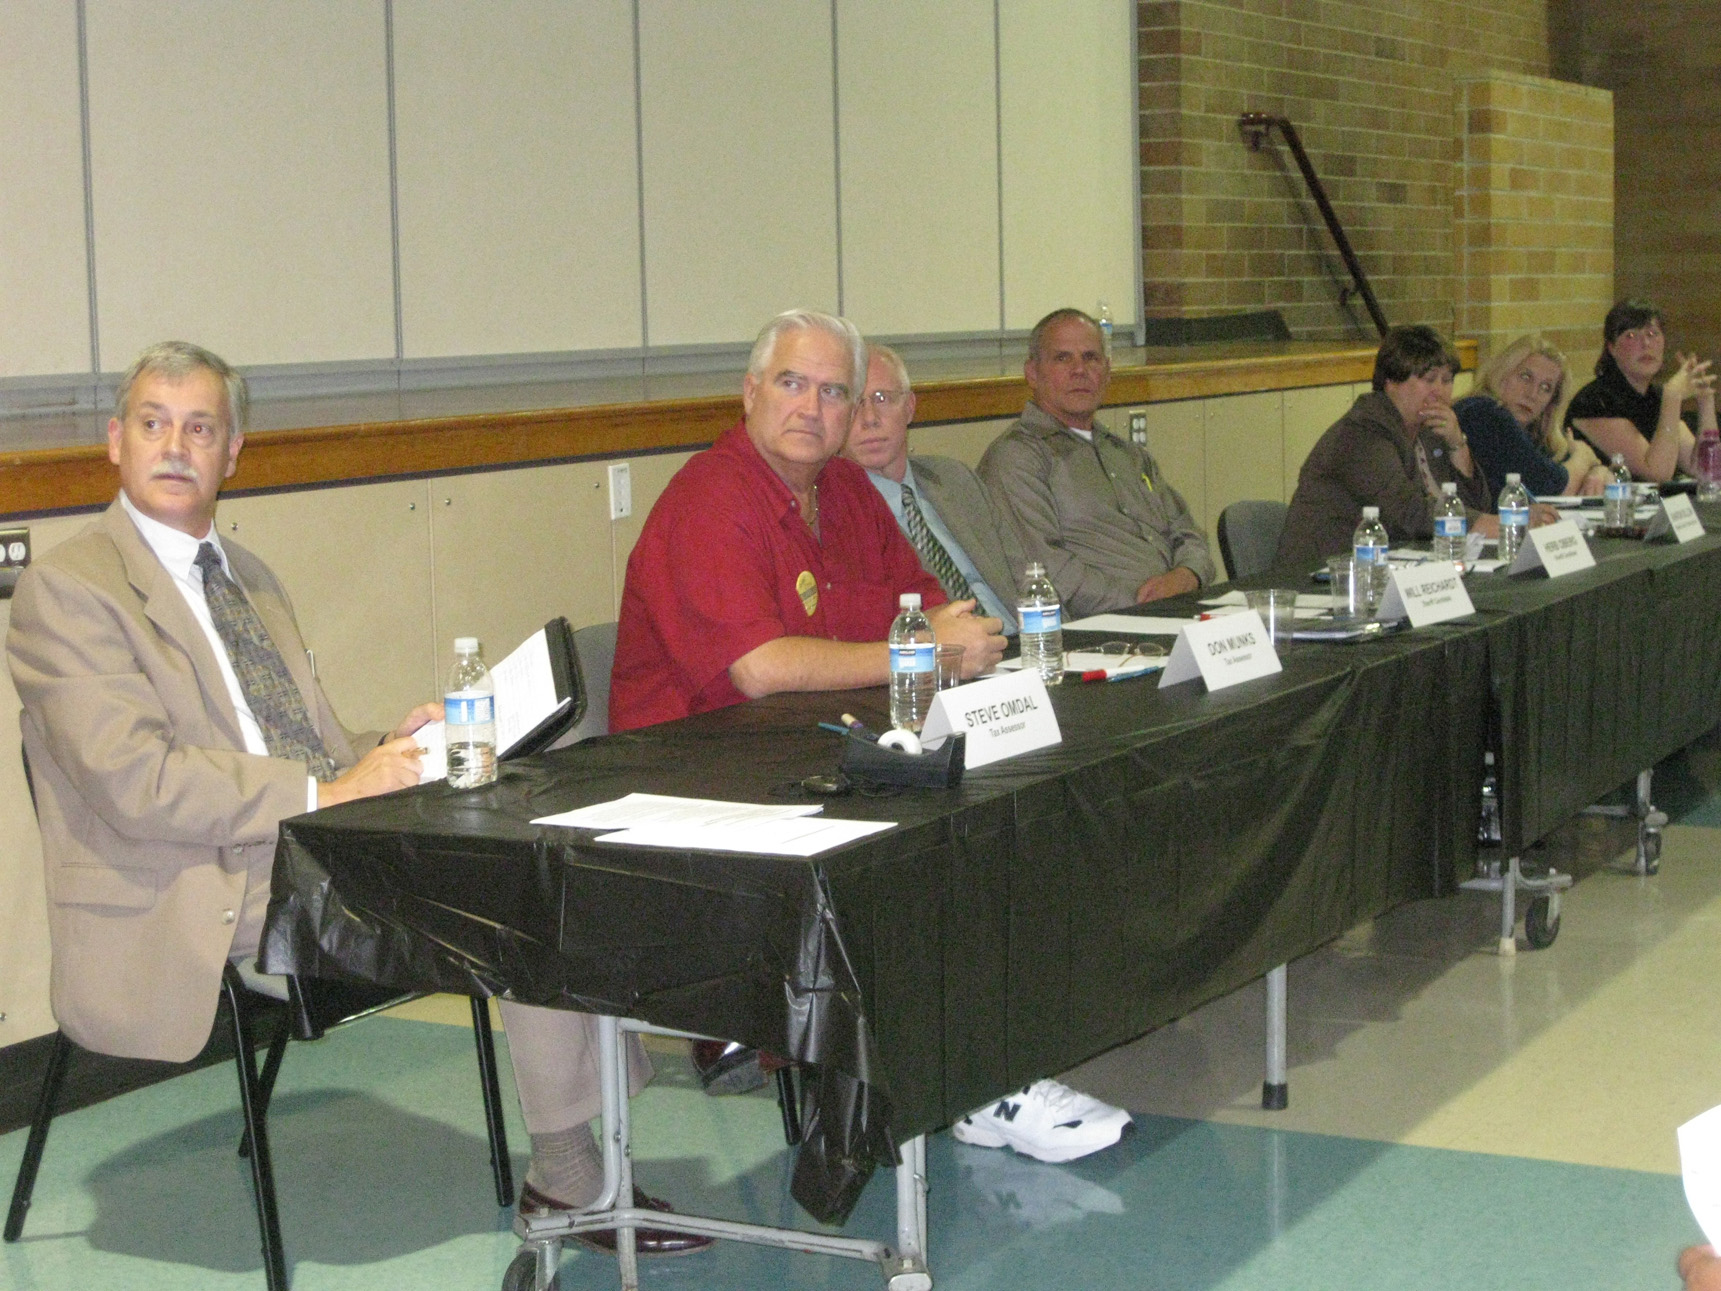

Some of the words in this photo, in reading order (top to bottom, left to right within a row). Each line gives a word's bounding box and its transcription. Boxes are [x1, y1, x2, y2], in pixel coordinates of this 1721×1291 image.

[1405, 585, 1421, 598] WILL
[1208, 640, 1227, 656] DON
[1227, 632, 1256, 650] MUNKS
[965, 705, 1000, 727] STEVE
[1001, 696, 1038, 717] OMDAL
[989, 728, 1000, 737] Tax
[1001, 722, 1026, 735] Assessor
[993, 1100, 1022, 1122] N
